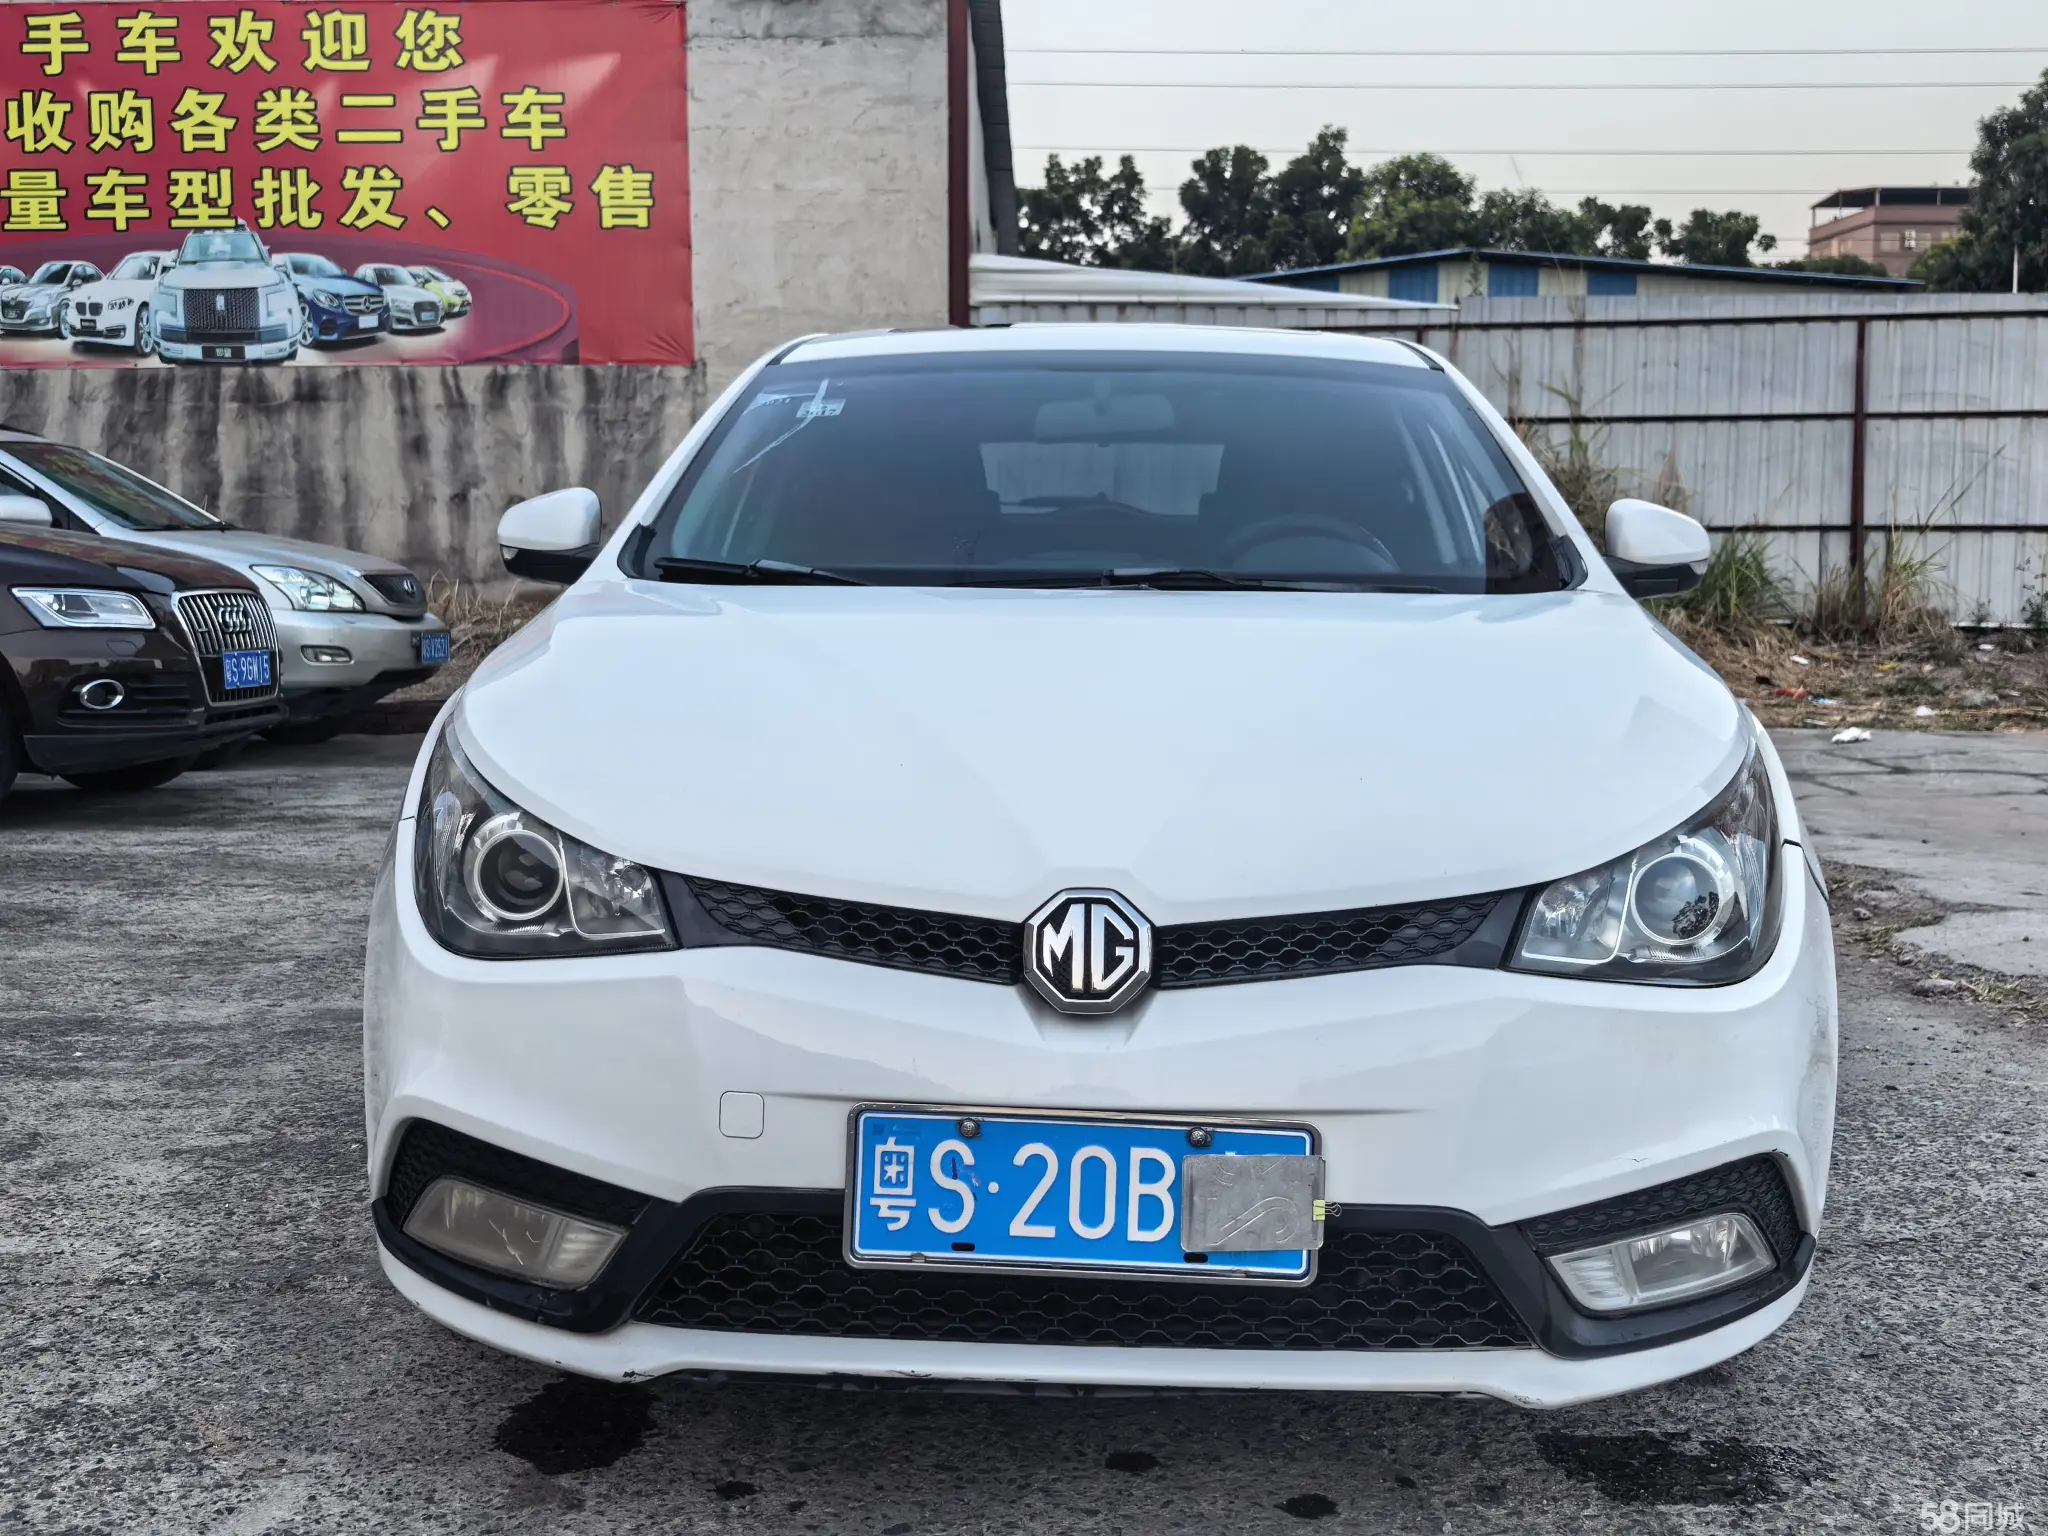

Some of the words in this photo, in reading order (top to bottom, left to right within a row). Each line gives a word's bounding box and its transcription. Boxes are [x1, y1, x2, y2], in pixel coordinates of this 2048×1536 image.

[20, 9, 465, 75] 手车欢迎您
[4, 85, 568, 153] 收购各类二手车
[1043, 903, 1135, 993] MG
[869, 1136, 1177, 1243] 粤S·20B
